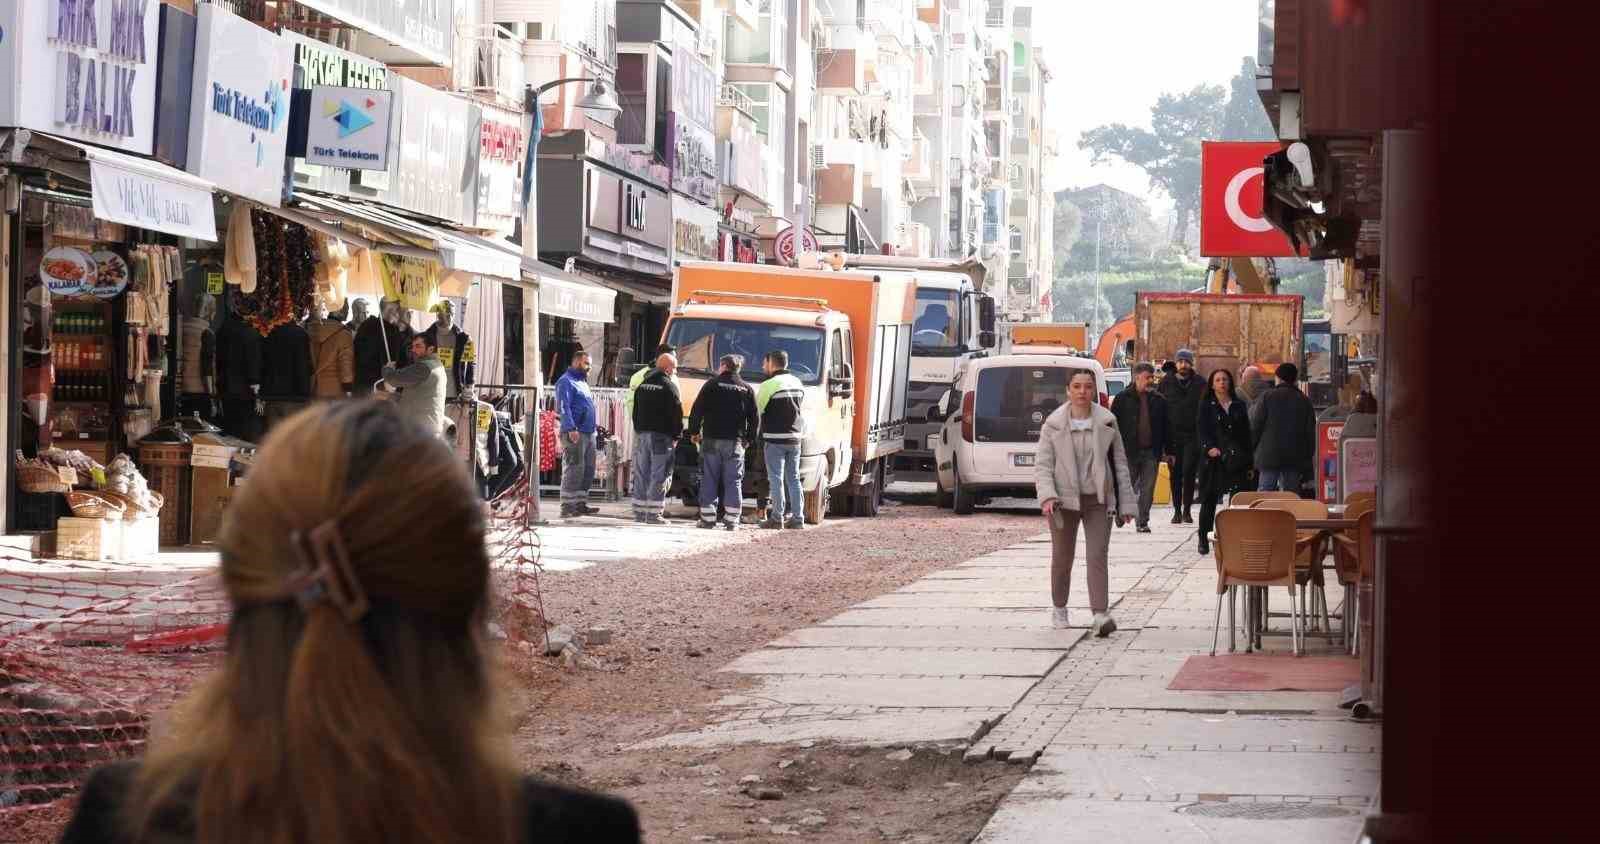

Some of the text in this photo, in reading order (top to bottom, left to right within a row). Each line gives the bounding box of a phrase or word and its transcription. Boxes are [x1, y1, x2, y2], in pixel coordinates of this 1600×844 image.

[60, 51, 136, 137] BALIK
[213, 82, 269, 131] Türk Telekom
[313, 146, 379, 161] Türk Telekom
[48, 279, 81, 289] KALAMAR
